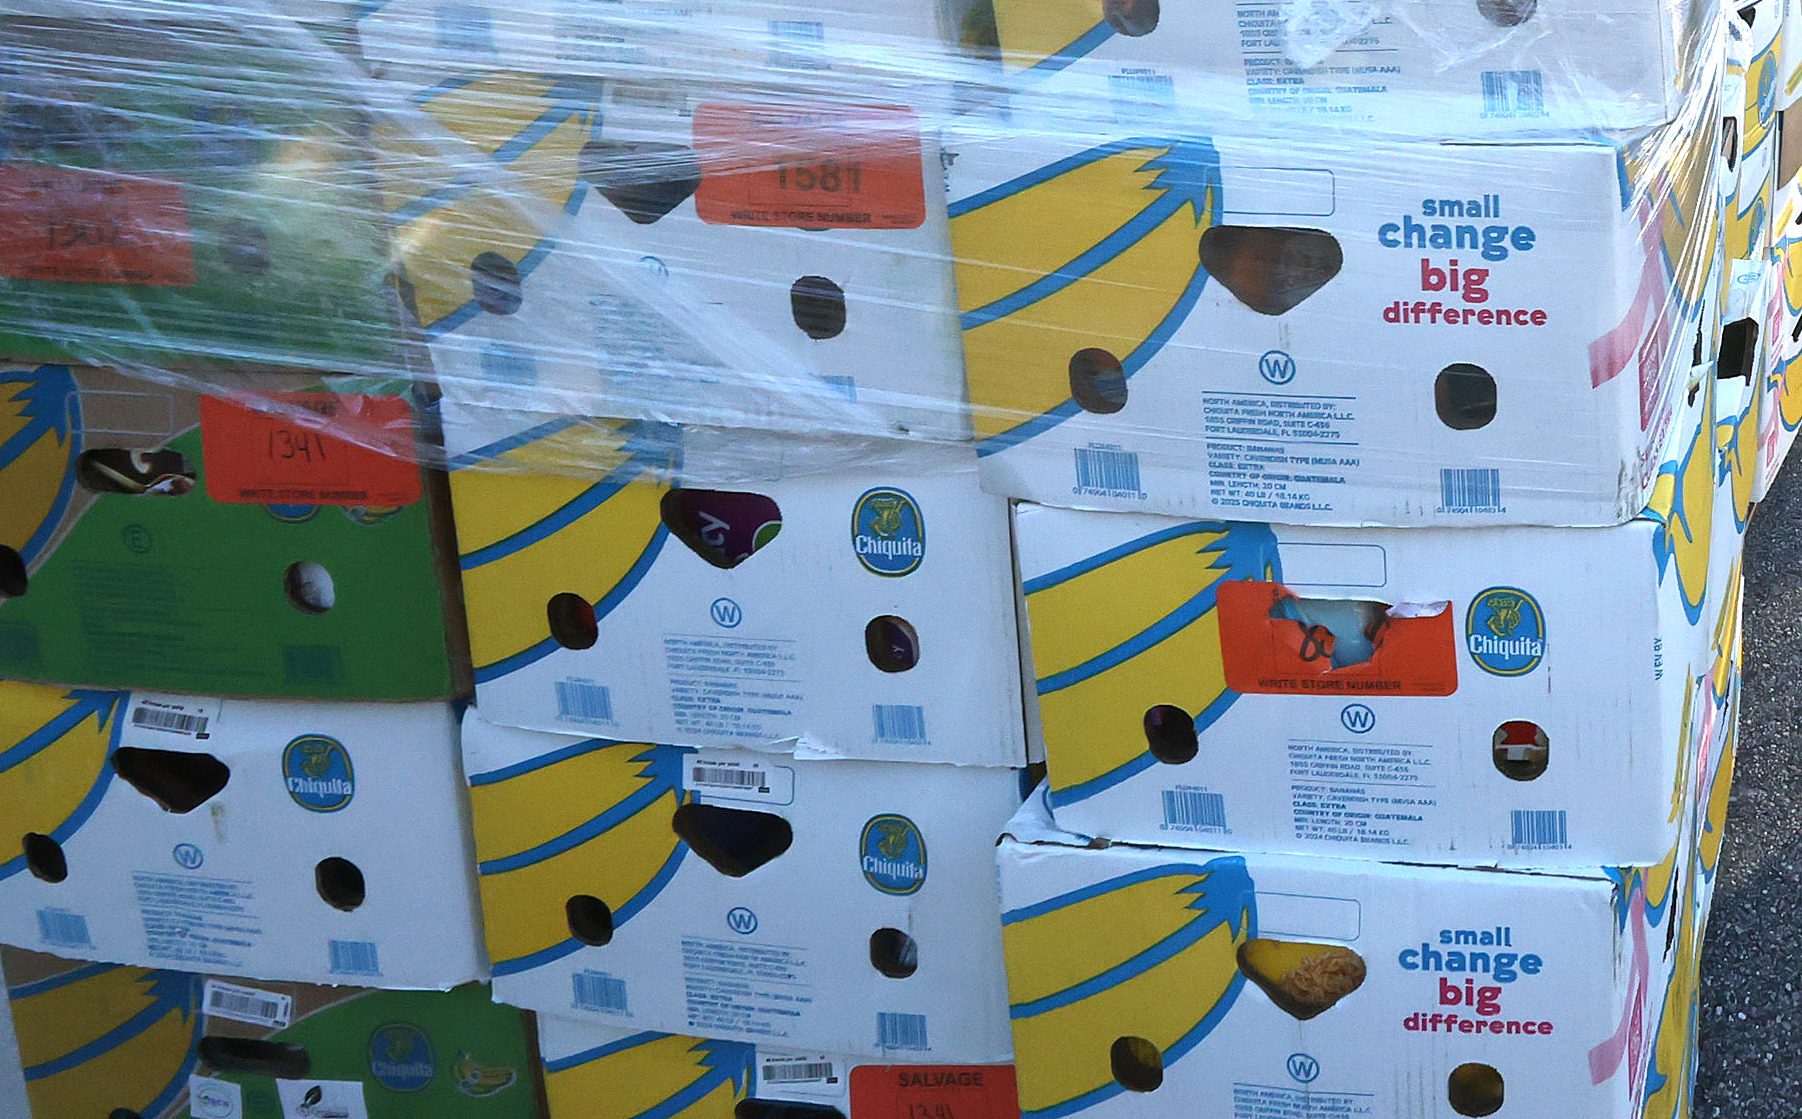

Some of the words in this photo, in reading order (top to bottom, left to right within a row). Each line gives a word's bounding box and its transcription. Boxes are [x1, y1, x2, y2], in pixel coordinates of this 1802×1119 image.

[1422, 194, 1499, 218] small
[1378, 215, 1536, 262] change
[1421, 258, 1490, 303] big
[1383, 301, 1548, 326] difference
[854, 534, 922, 561] Chiquita
[1469, 633, 1542, 661] Chiquita
[1259, 678, 1298, 689] WRITE
[1301, 679, 1344, 690] STORE
[1347, 679, 1402, 691] NUMBER
[287, 776, 352, 799] Chiquita
[863, 855, 924, 880] Chiquita
[1439, 926, 1511, 947] small
[1398, 943, 1543, 984] change
[1439, 977, 1502, 1016] big
[1403, 1012, 1554, 1035] difference
[899, 1071, 985, 1088] SALVAGE
